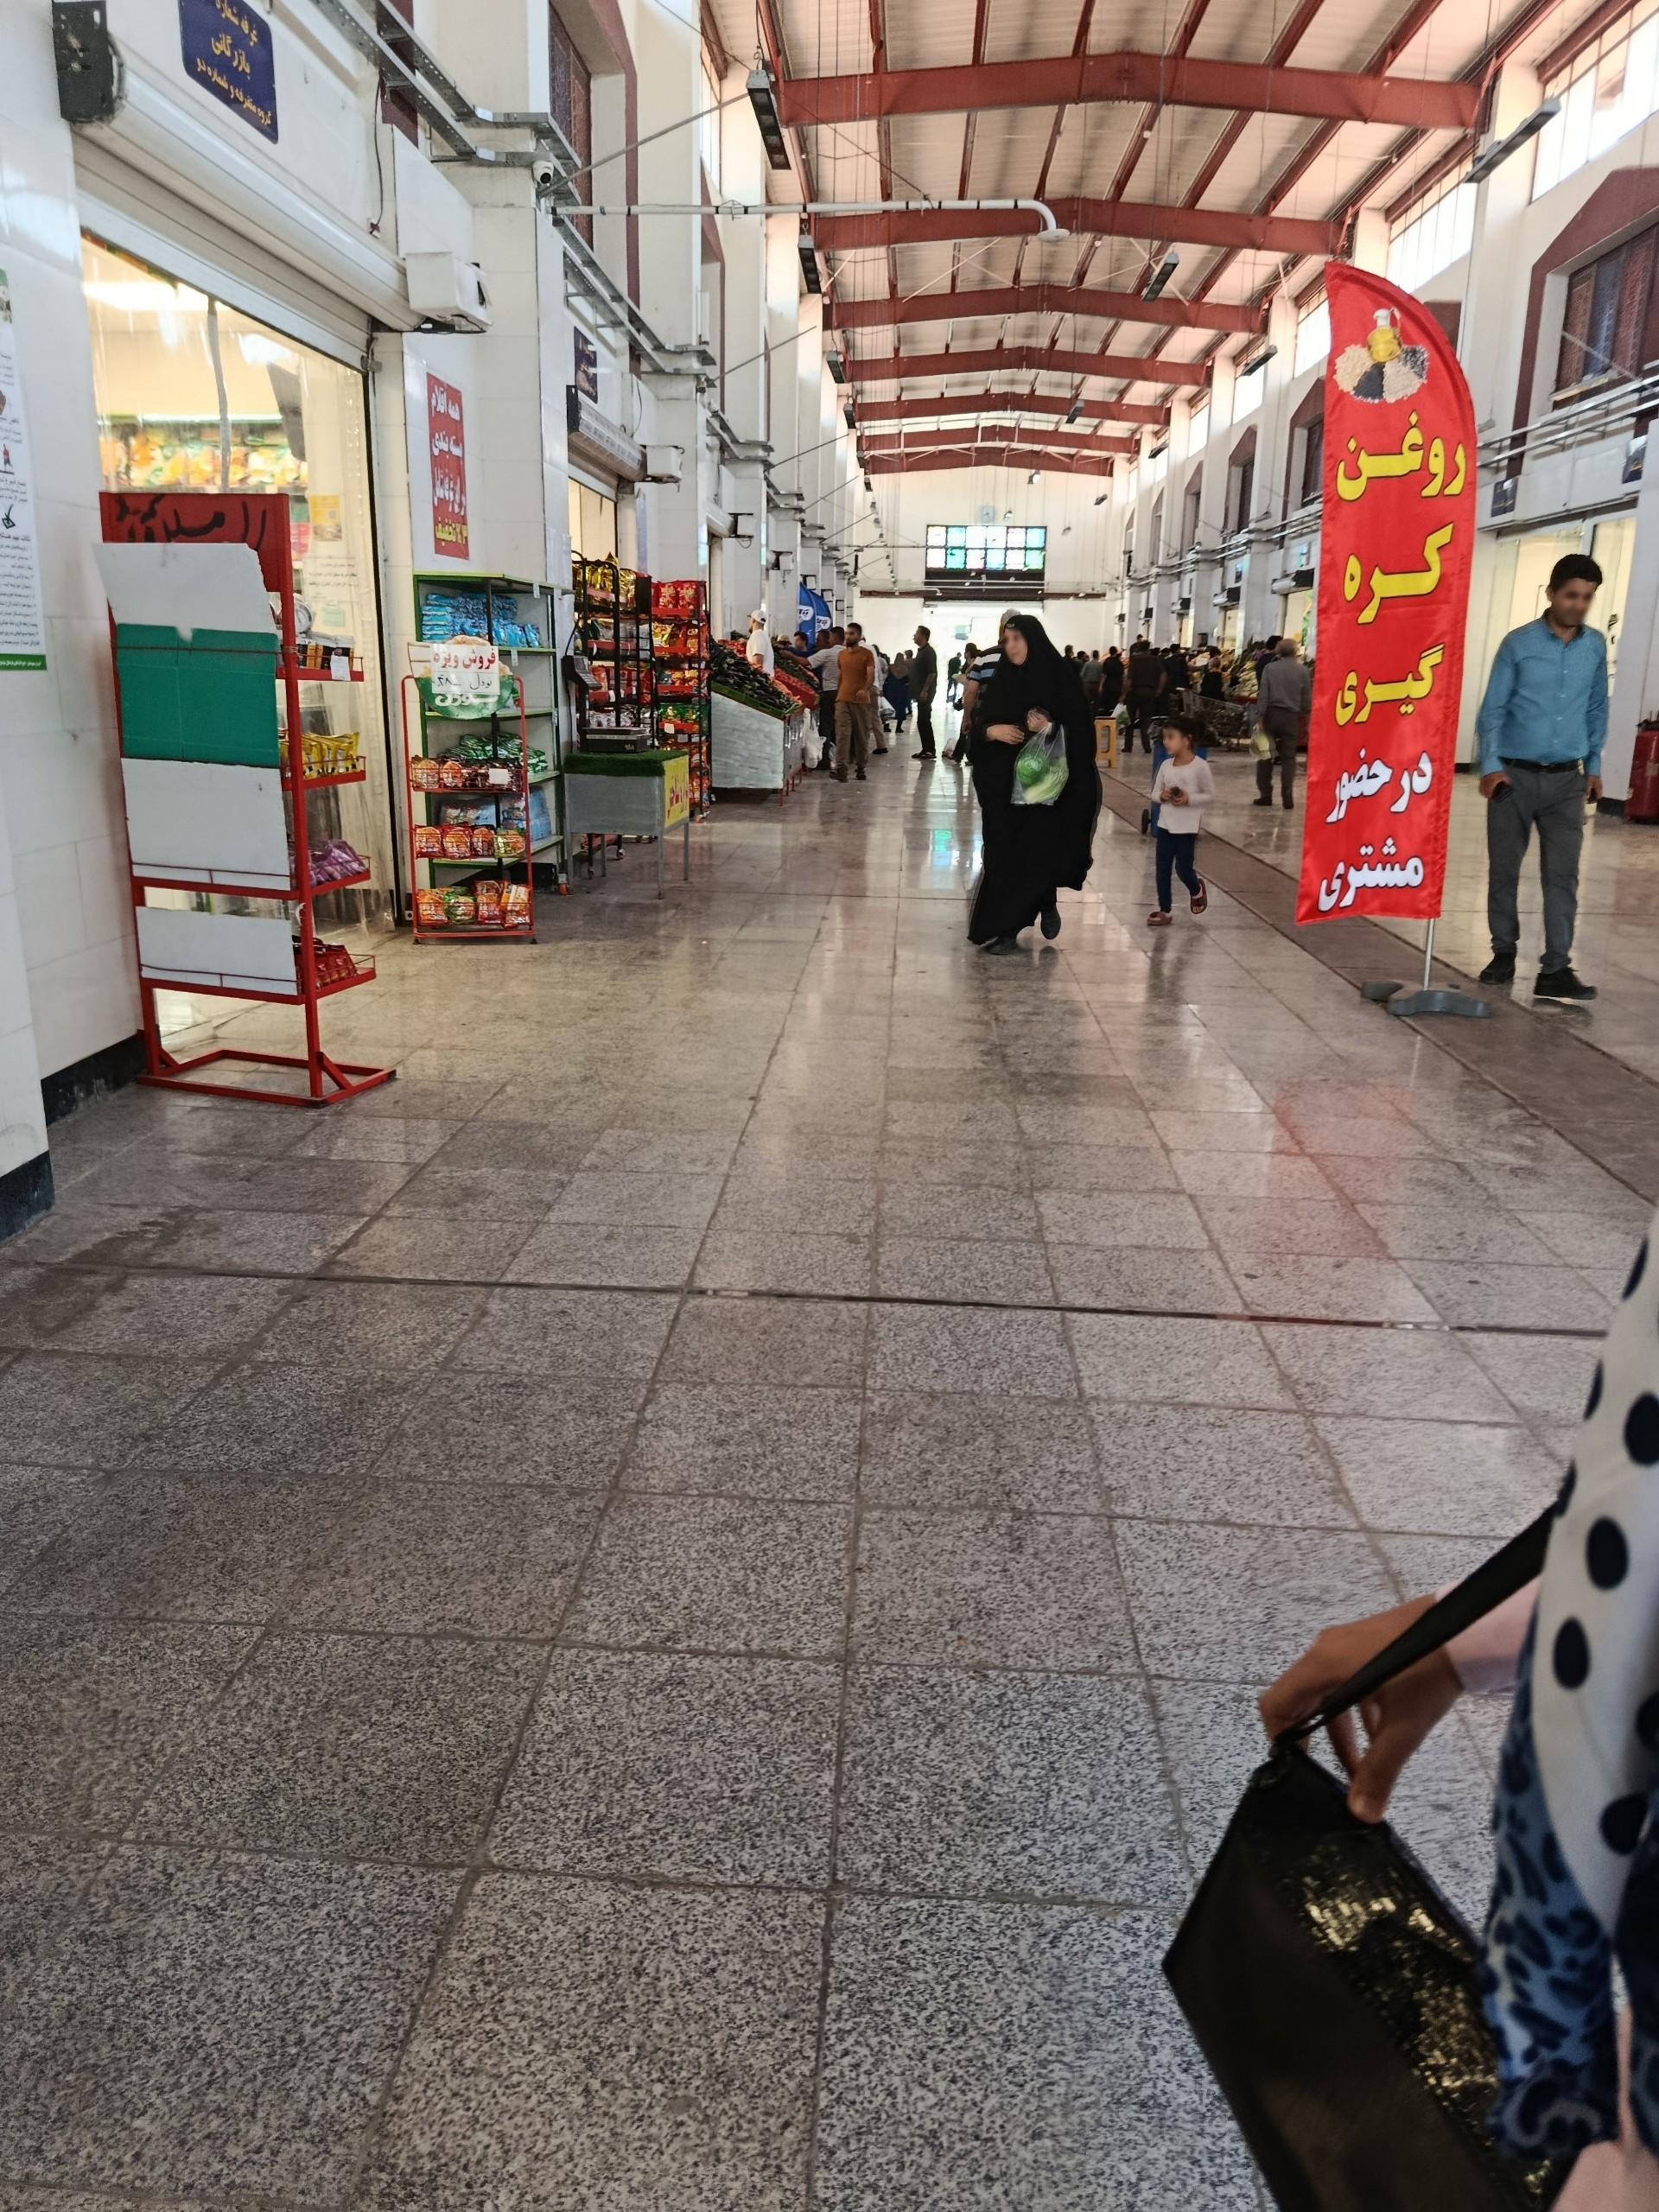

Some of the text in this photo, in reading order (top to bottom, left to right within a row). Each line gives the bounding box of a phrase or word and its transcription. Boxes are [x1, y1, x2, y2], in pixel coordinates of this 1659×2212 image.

[211, 33, 251, 80] بازرگانی
[431, 385, 461, 422] همه اقلام
[1335, 409, 1467, 502] روغن
[1343, 521, 1455, 626] کره
[434, 648, 496, 669] فروش ویژه
[1334, 643, 1446, 727] گیری
[1325, 747, 1433, 823] در حضور
[1318, 836, 1425, 912] مشتری
